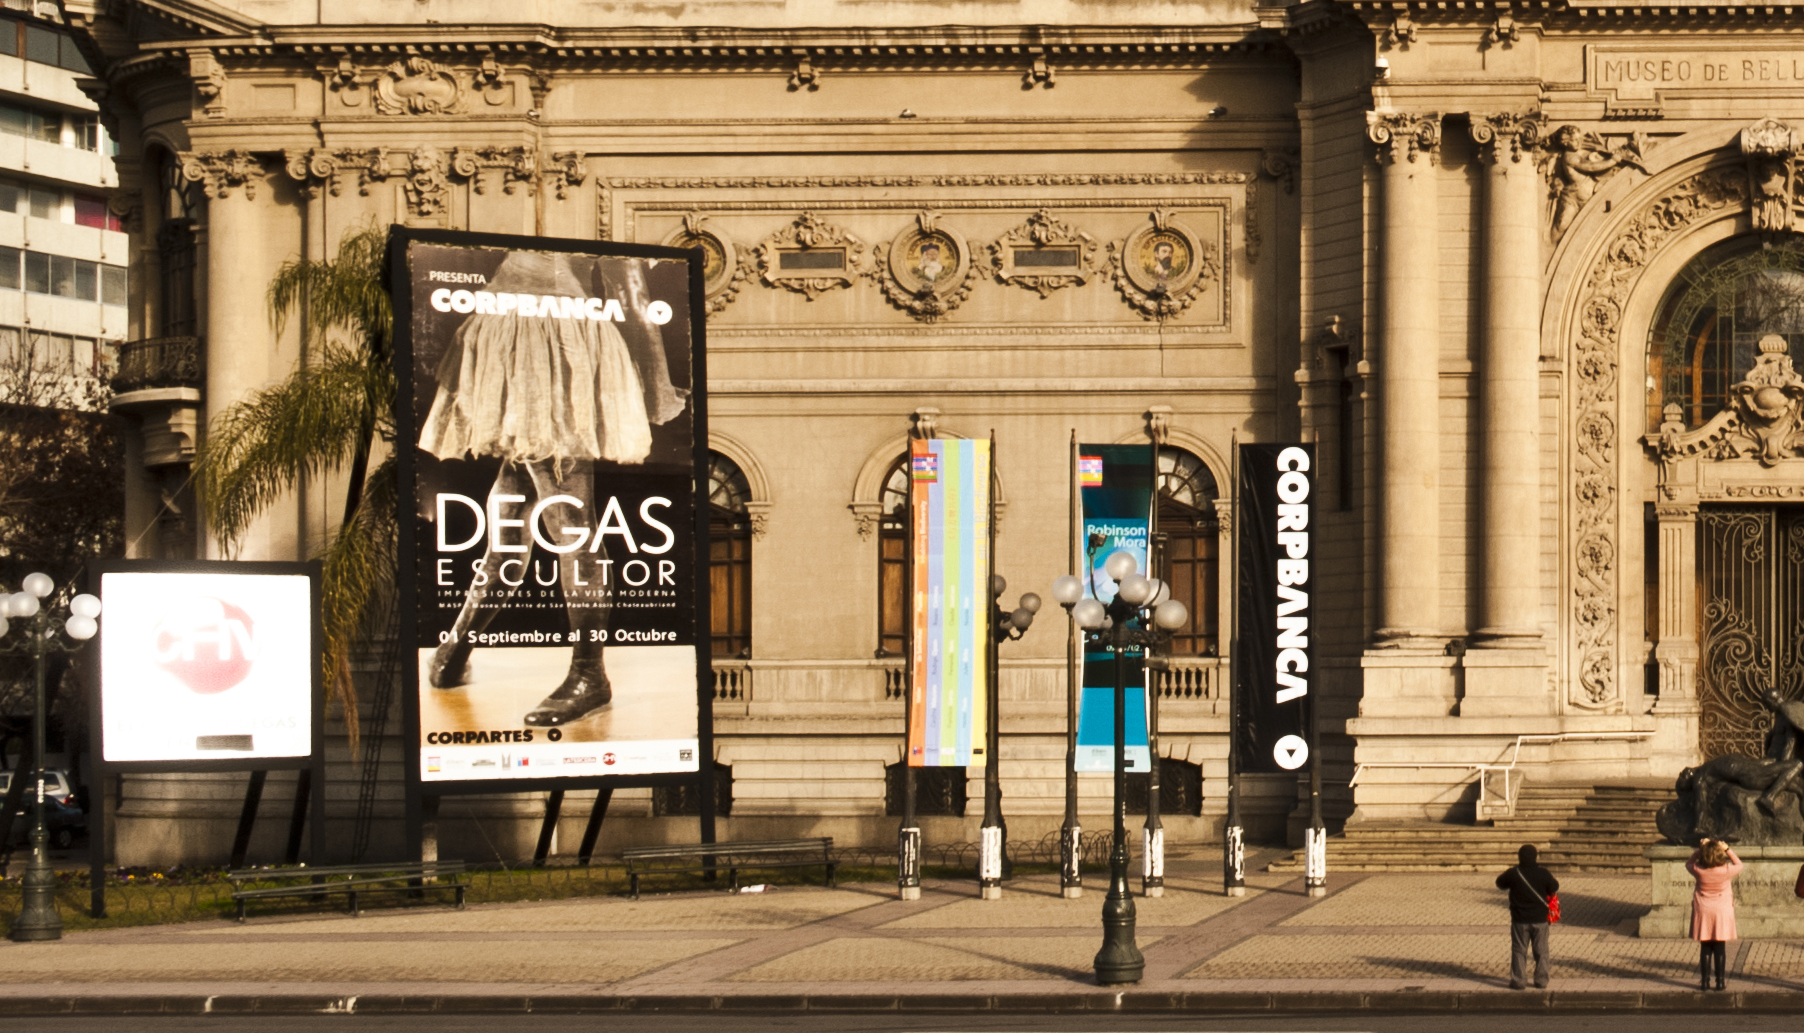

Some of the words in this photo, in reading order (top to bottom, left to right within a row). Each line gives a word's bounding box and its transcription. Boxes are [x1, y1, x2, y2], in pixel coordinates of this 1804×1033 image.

[1604, 60, 1691, 82] MUSEO
[1704, 63, 1729, 81] DE
[429, 270, 487, 285] PRESENTA
[430, 288, 626, 322] CORPBANCA
[975, 454, 987, 523] Biodiverso
[436, 492, 675, 554] DEGAS
[1087, 523, 1146, 536] Robinson
[975, 527, 987, 540] lo
[1114, 536, 1146, 548] Mora
[977, 544, 987, 560] en
[437, 558, 676, 586] ESCULTOR
[1276, 446, 1310, 704] CORPBANCA
[439, 631, 459, 643] 01
[467, 630, 561, 645] Septiembre
[567, 629, 580, 642] al
[590, 629, 608, 642] 30
[614, 628, 677, 642] Octubre
[427, 729, 533, 744] CORPARTES
